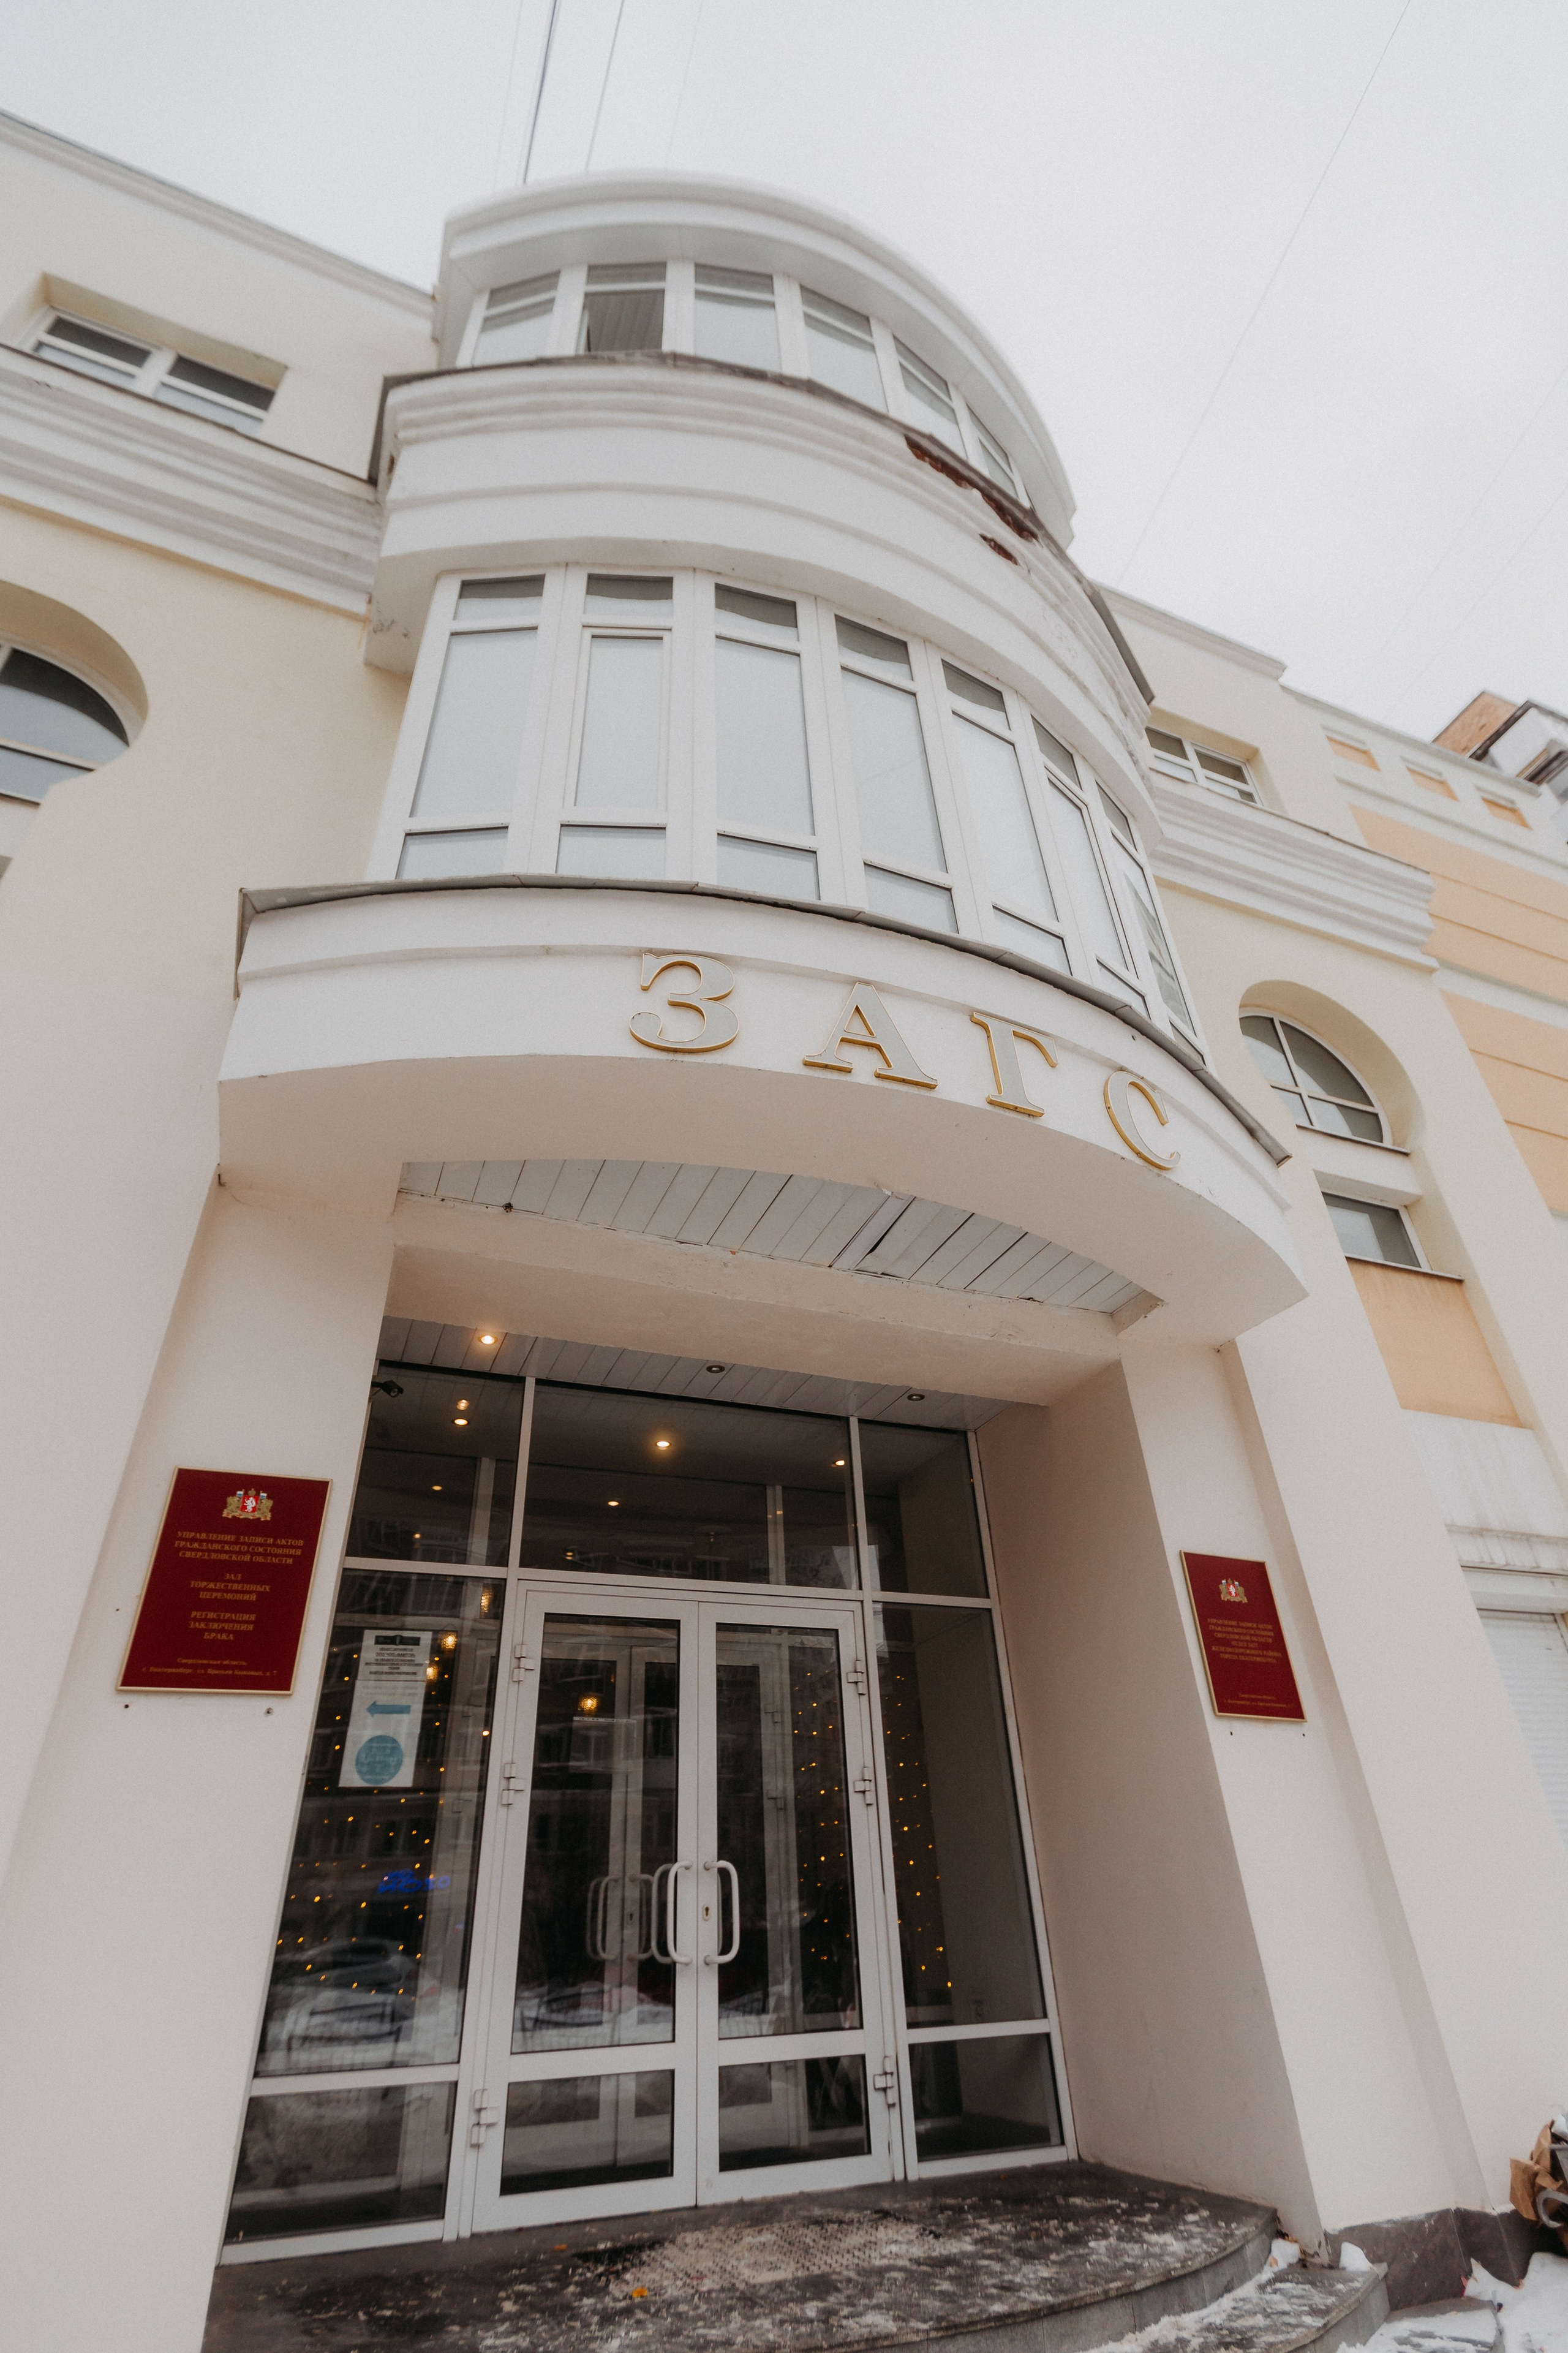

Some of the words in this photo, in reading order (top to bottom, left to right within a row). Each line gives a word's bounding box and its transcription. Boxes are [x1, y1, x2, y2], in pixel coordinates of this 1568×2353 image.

[629, 953, 1181, 1170] ЗАГС
[178, 1531, 236, 1541] УПРАВЛЕНИЕ
[175, 1541, 247, 1552] ГРАЖДАНСКОГО
[249, 1546, 302, 1555] СОСТОЯНИЯ
[179, 1550, 251, 1562] СВЕРДЛОВСКОЙ
[252, 1555, 293, 1564] ОБЛАСТИ
[190, 1581, 270, 1592] ТОРЖЕСТВЕННЫХ
[199, 1592, 257, 1601] ЦЕРЕМОНИЙ
[190, 1611, 256, 1620] РЕГИСТРАЦИЯ
[189, 1621, 254, 1631] ЗАКЛЮЧЕНИЯ
